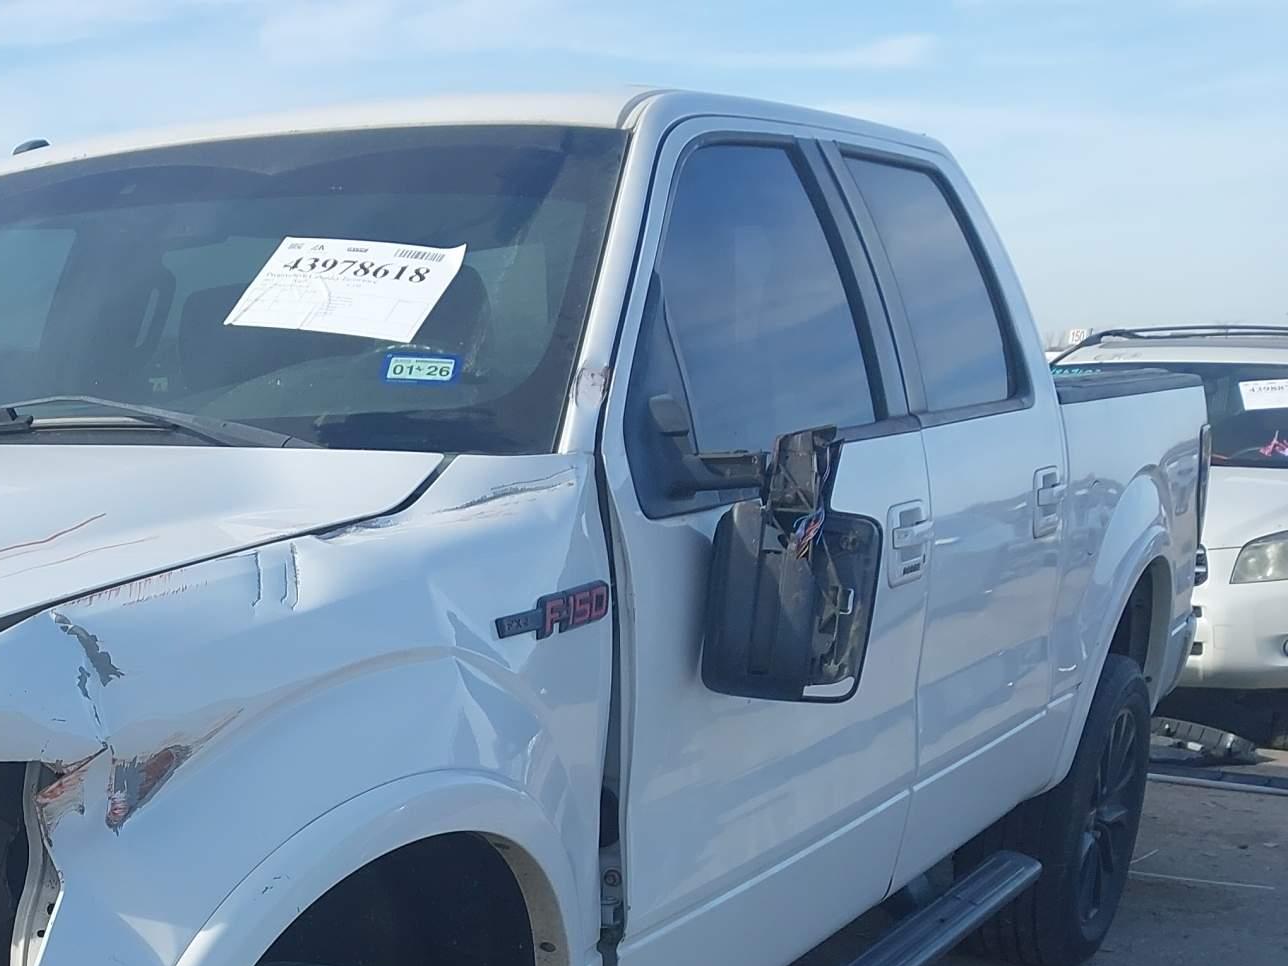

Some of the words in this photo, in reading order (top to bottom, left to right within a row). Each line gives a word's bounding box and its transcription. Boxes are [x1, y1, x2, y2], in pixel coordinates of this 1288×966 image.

[282, 256, 431, 284] 43978618
[392, 364, 414, 376] 01
[426, 365, 451, 377] 26
